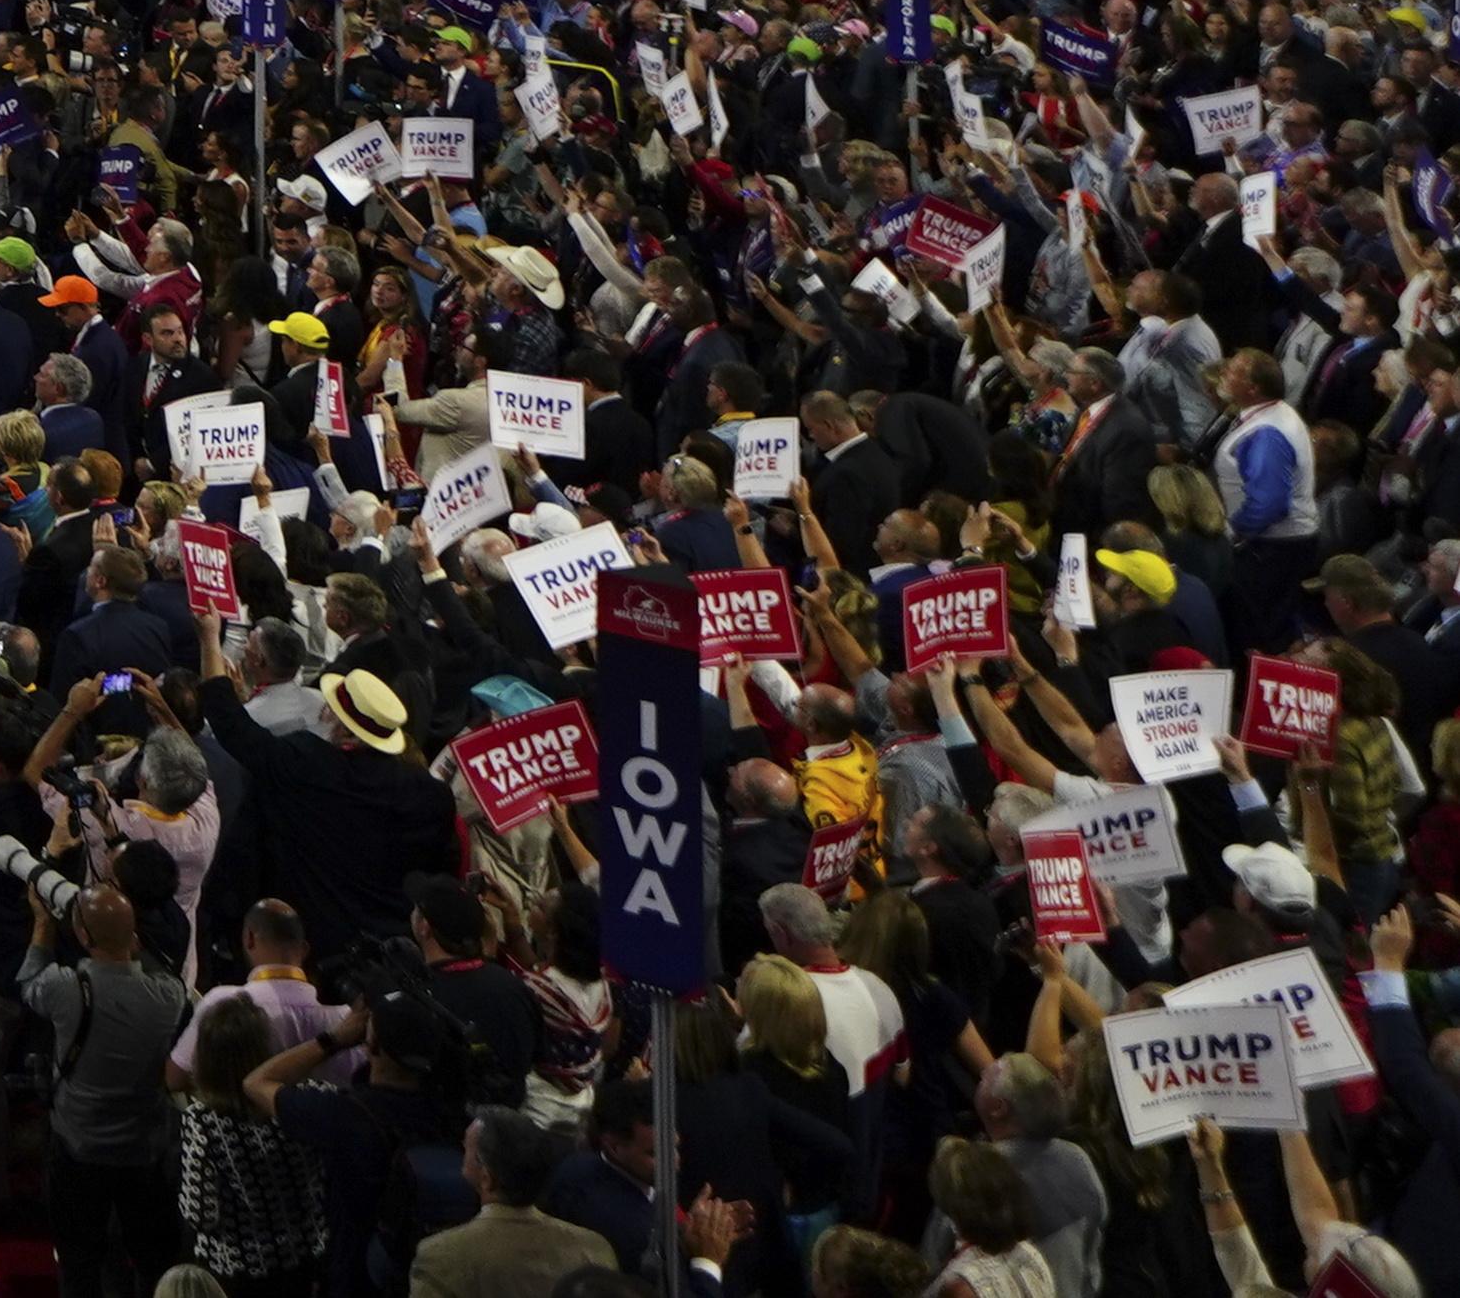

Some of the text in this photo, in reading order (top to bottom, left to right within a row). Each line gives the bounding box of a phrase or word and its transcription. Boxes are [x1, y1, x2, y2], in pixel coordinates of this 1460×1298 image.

[1045, 29, 1108, 63] TRUMP
[1195, 101, 1254, 124] TRUMP
[1204, 115, 1250, 135] VANCE
[408, 131, 466, 146] TRUMP
[412, 145, 459, 159] VANCE
[101, 159, 134, 173] TRUMP
[328, 137, 384, 174] TRUMP
[922, 208, 982, 242] TRUMP
[922, 225, 970, 253] VANCE
[494, 390, 573, 416] TRUMP
[199, 424, 261, 446] TRUMP
[500, 411, 563, 431] VANCE
[205, 443, 256, 461] VANCE
[184, 541, 229, 571] TRUMP
[192, 565, 227, 591] VANCE
[525, 549, 618, 595] TRUMP
[908, 587, 998, 625] TRUMP
[916, 610, 988, 641] VANCE
[1143, 686, 1189, 704] MAKE
[1259, 678, 1336, 717] TRUMP
[1136, 702, 1202, 726] AMERICA
[1269, 704, 1330, 737] VANCE
[1143, 719, 1199, 743] STRONG
[468, 723, 584, 781] TRUMP
[1155, 736, 1201, 761] AGAIN!
[490, 748, 582, 796] VANCE
[611, 700, 689, 926] IOWA
[1028, 857, 1083, 886] TRUMP
[1034, 884, 1084, 908] VANCE
[1121, 1031, 1274, 1073] TRUMP
[1139, 1061, 1262, 1095] VANCE
